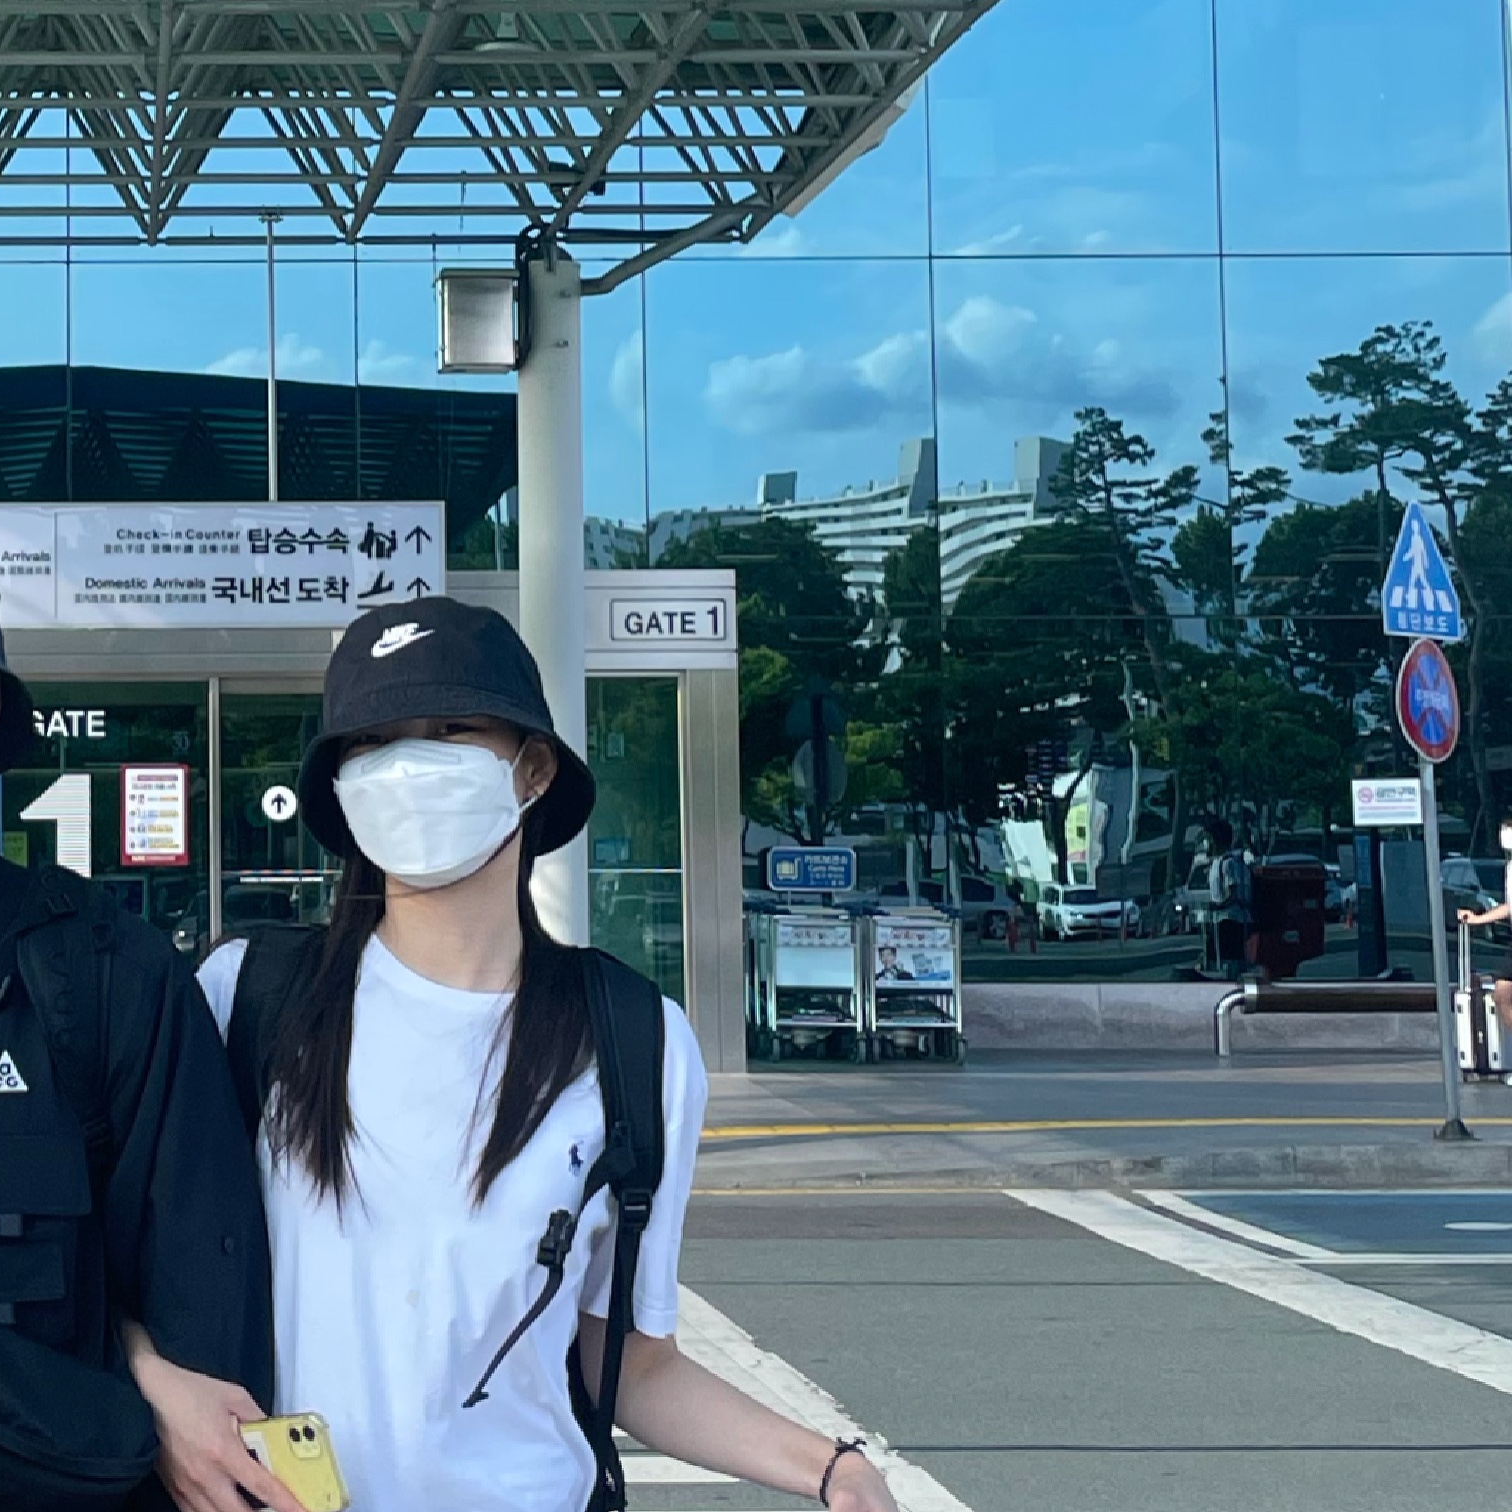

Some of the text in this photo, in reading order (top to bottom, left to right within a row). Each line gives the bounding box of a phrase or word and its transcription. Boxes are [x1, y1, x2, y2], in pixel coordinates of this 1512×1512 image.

[185, 529, 240, 541] Counter
[247, 527, 351, 555] 탑승수속
[1, 550, 51, 562] Arrivals
[85, 577, 206, 590] Domestic Arrivals
[211, 577, 350, 604] 국내선 도착
[624, 605, 719, 636] GATE 1
[18, 773, 93, 878] 1
